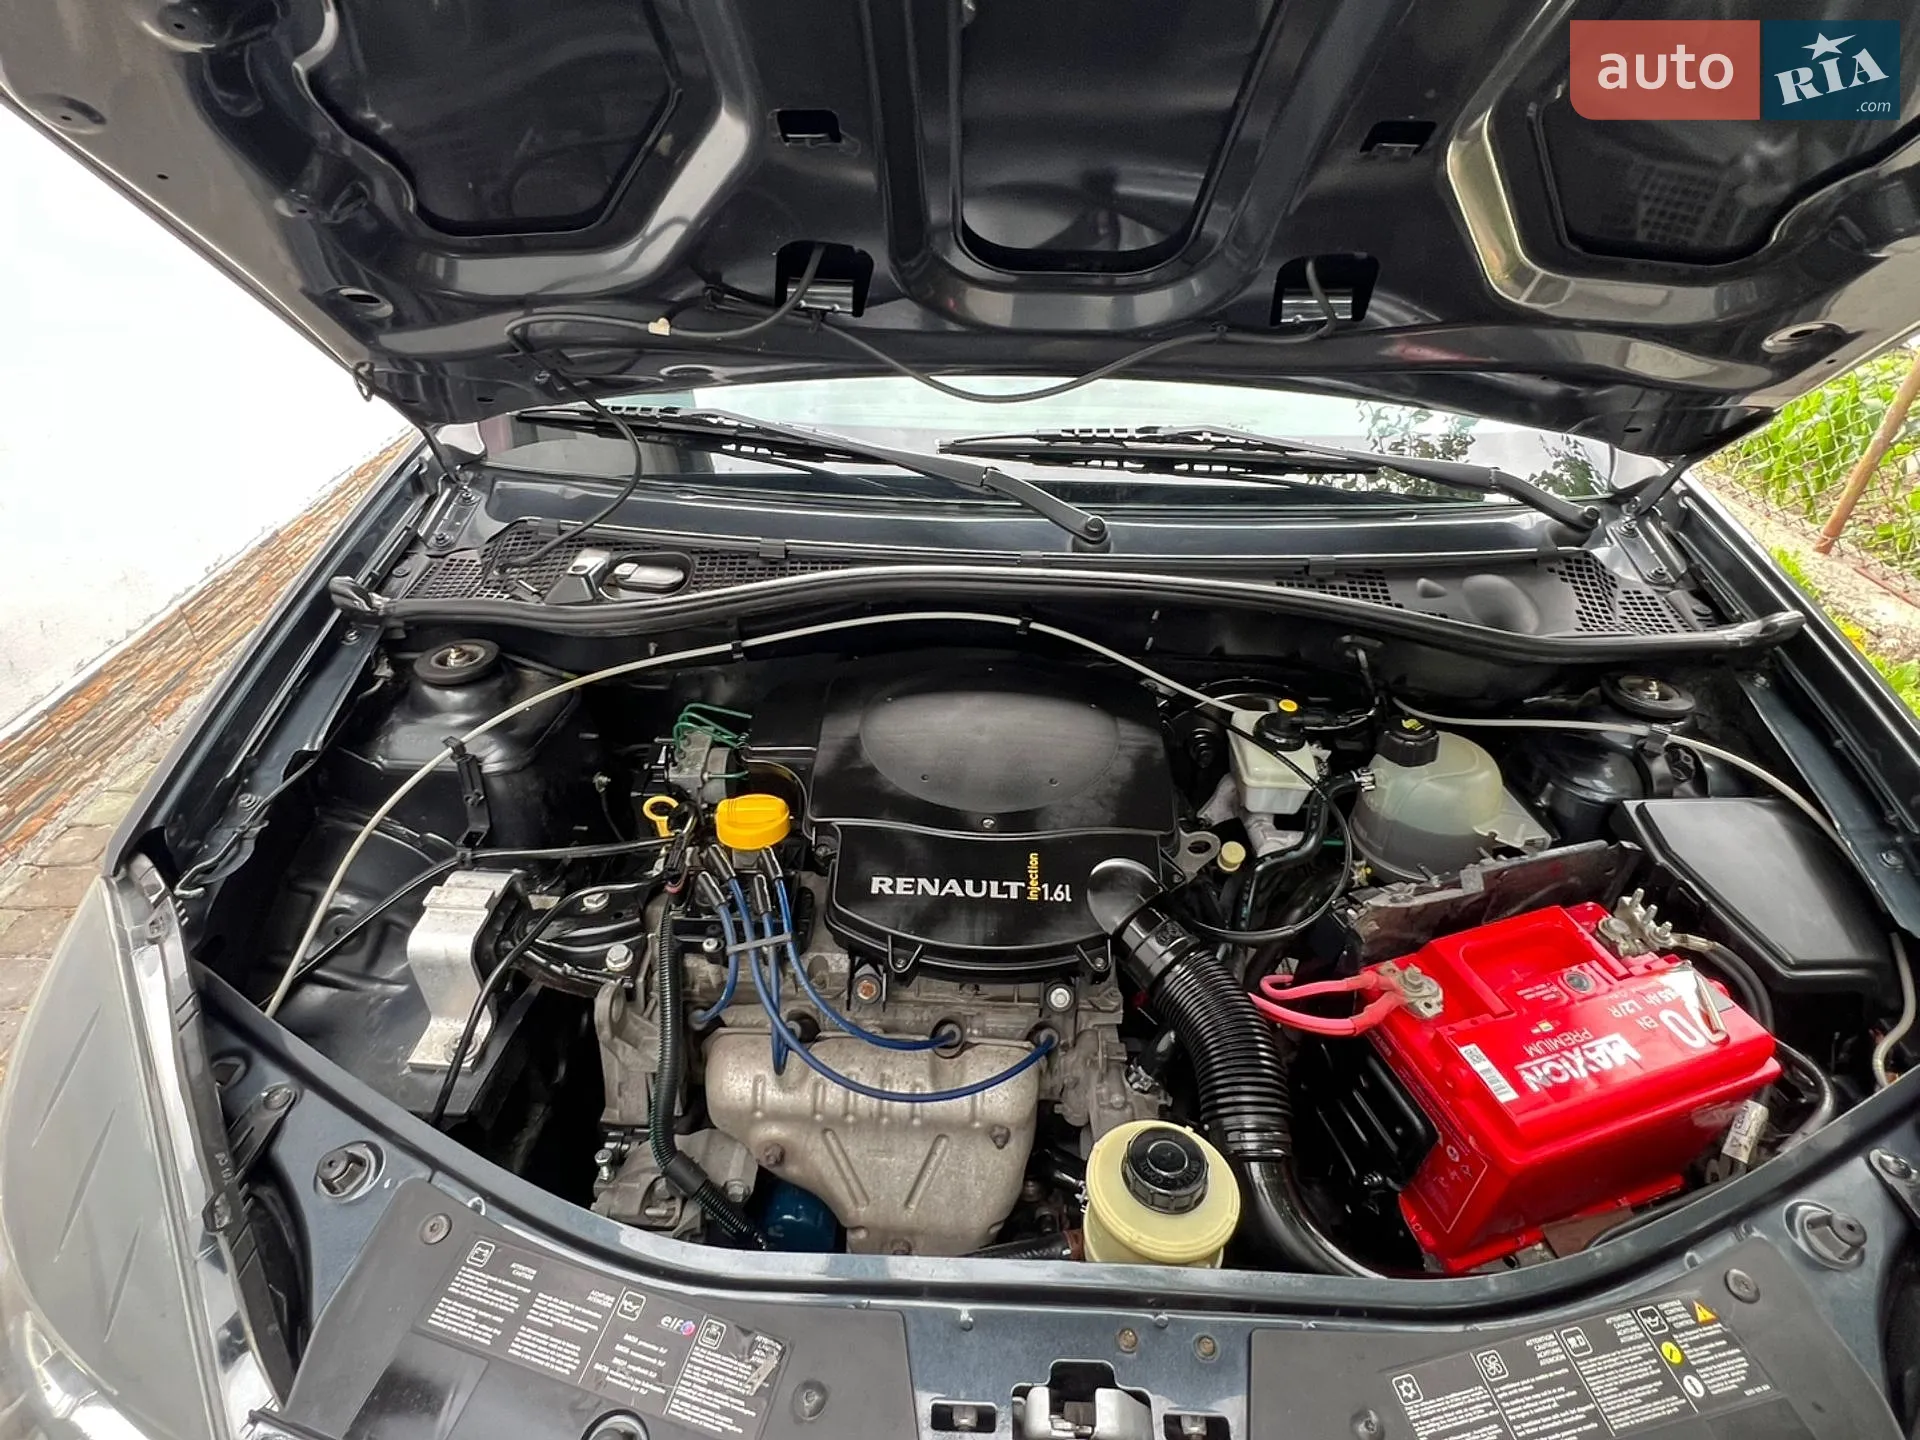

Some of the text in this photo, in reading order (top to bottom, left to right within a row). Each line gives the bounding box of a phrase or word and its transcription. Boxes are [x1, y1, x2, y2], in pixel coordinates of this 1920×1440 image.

[870, 876, 1025, 900] RENAULT
[1523, 1027, 1593, 1057] PREMIUM
[1516, 1033, 1642, 1093] MAXION
[660, 1315, 684, 1331] elf
